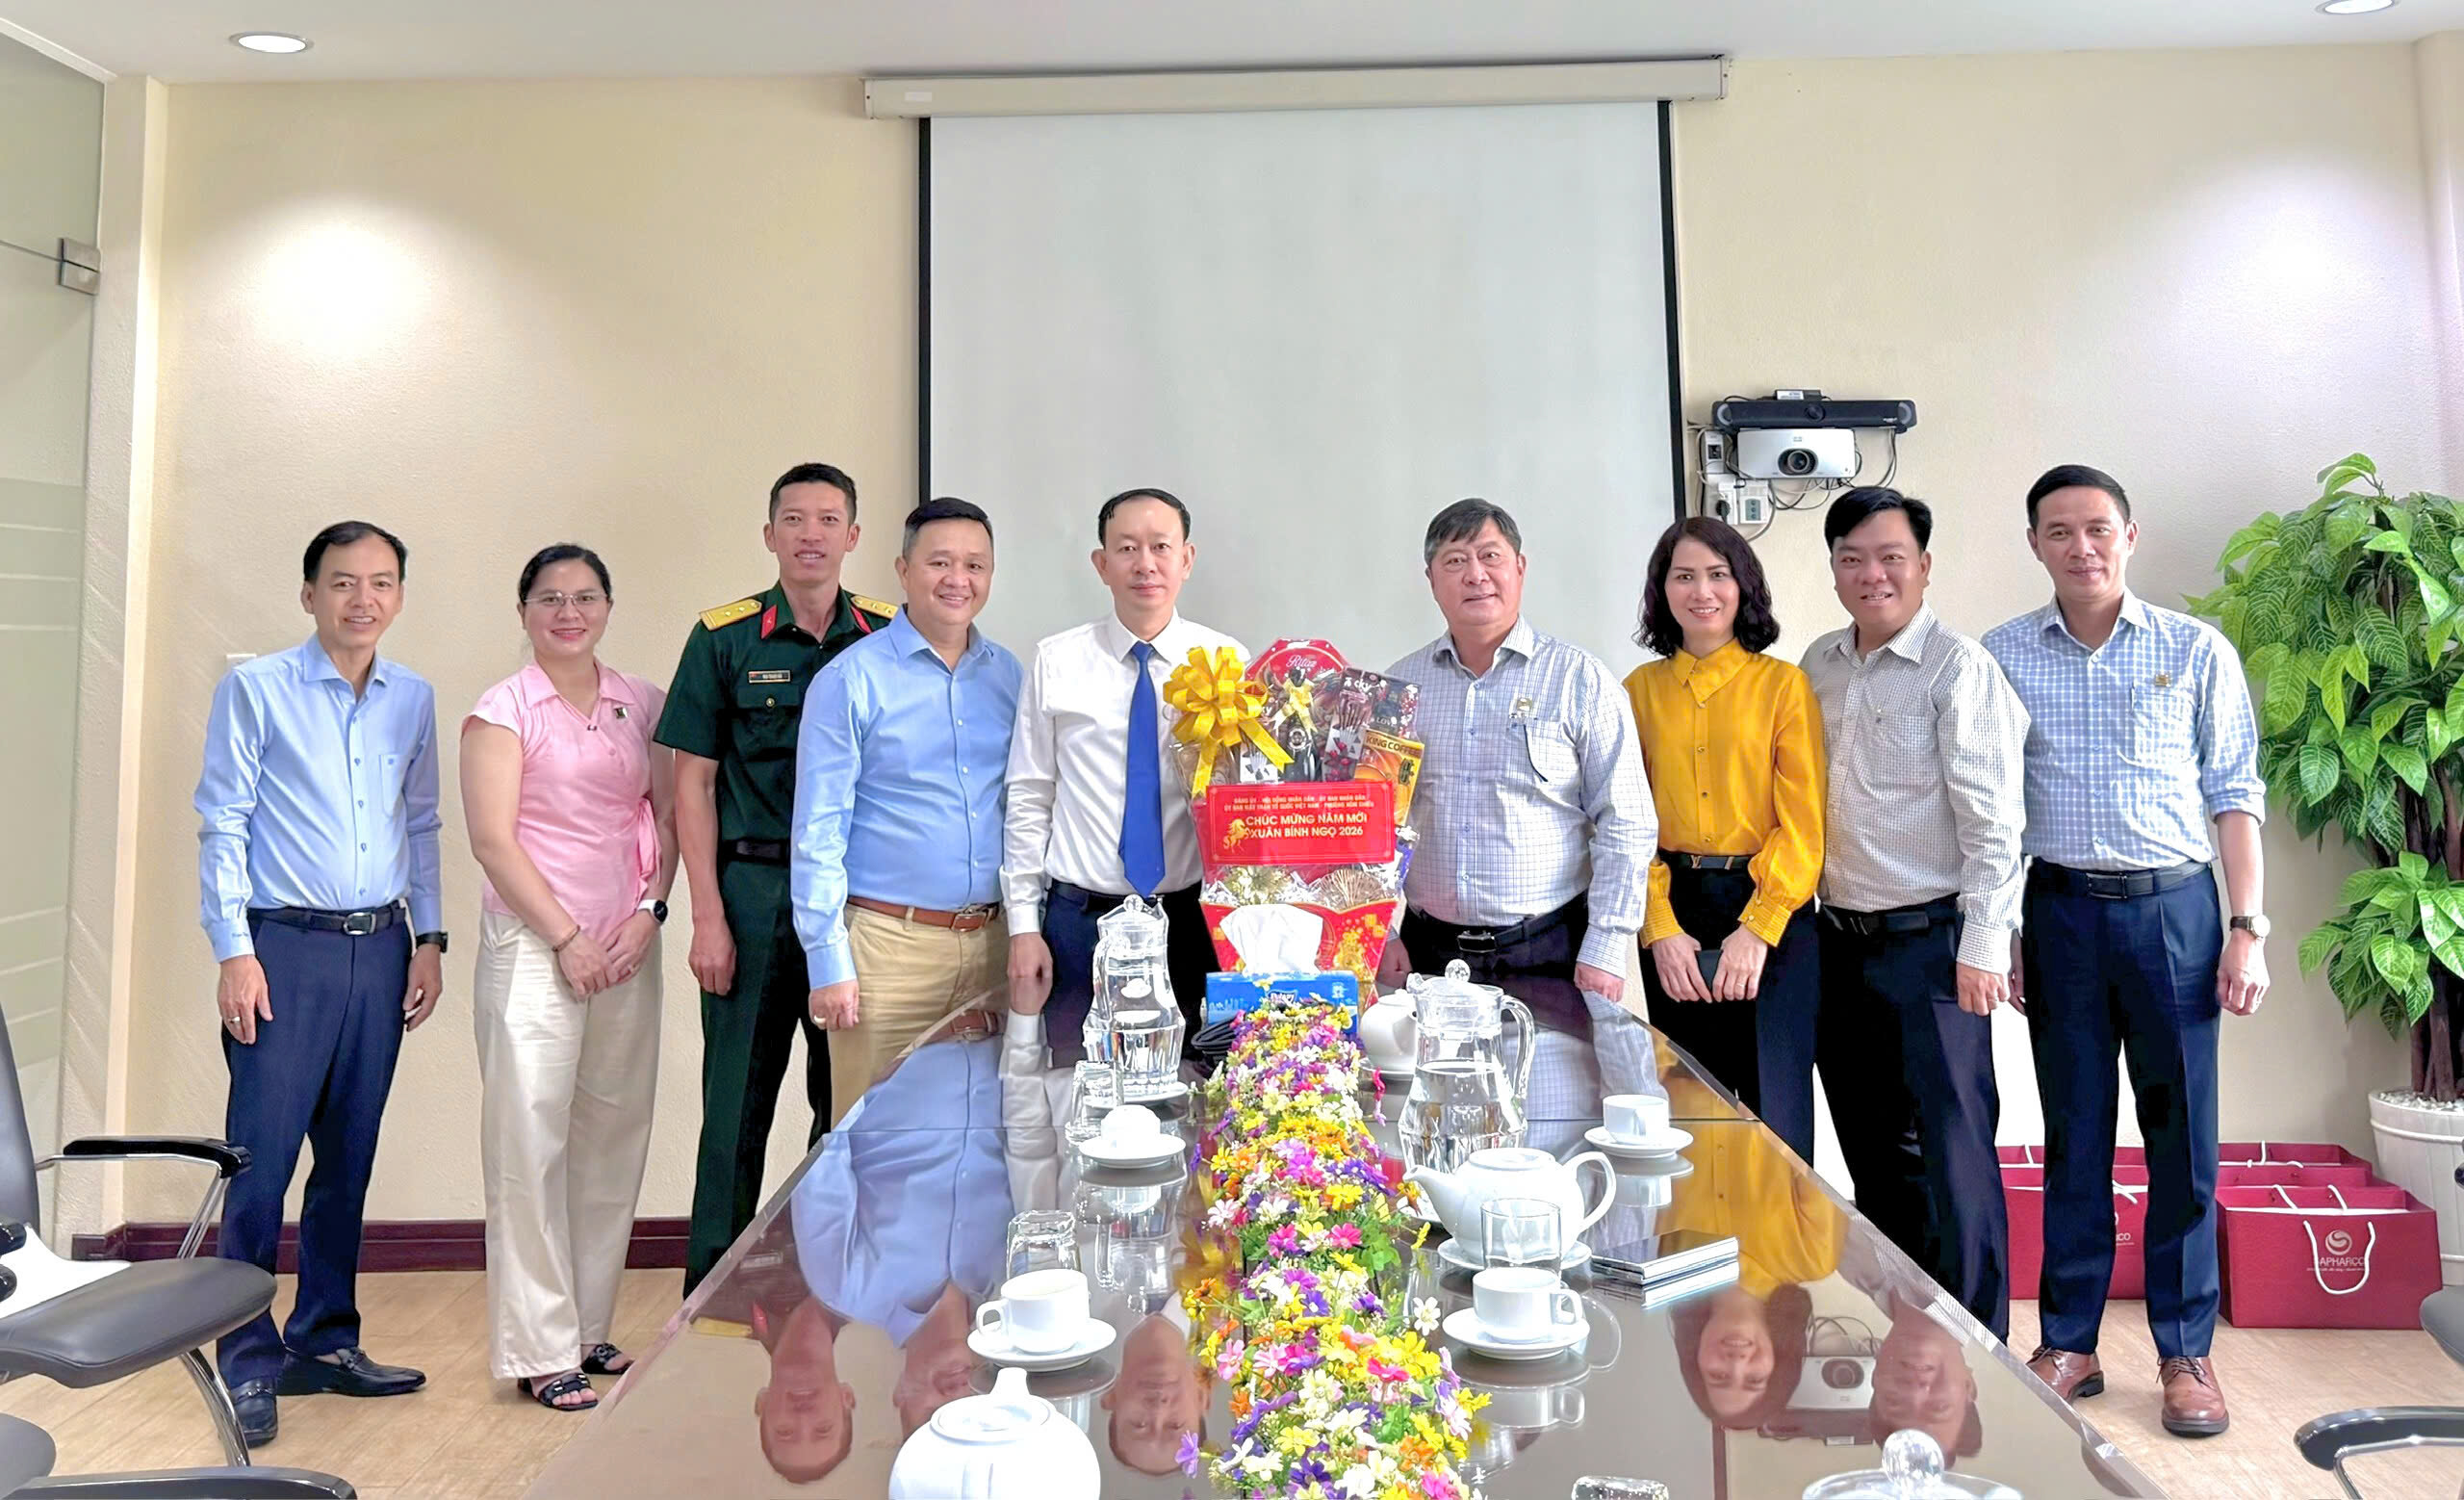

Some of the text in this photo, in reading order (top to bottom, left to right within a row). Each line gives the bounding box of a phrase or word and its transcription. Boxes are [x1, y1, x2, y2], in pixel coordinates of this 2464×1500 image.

[1368, 736, 1387, 748] KING
[1245, 811, 1368, 825] CHÚC MỪNG NĂM MỚI
[1250, 825, 1364, 839] XUÂN BÍNH NGỌ 2026
